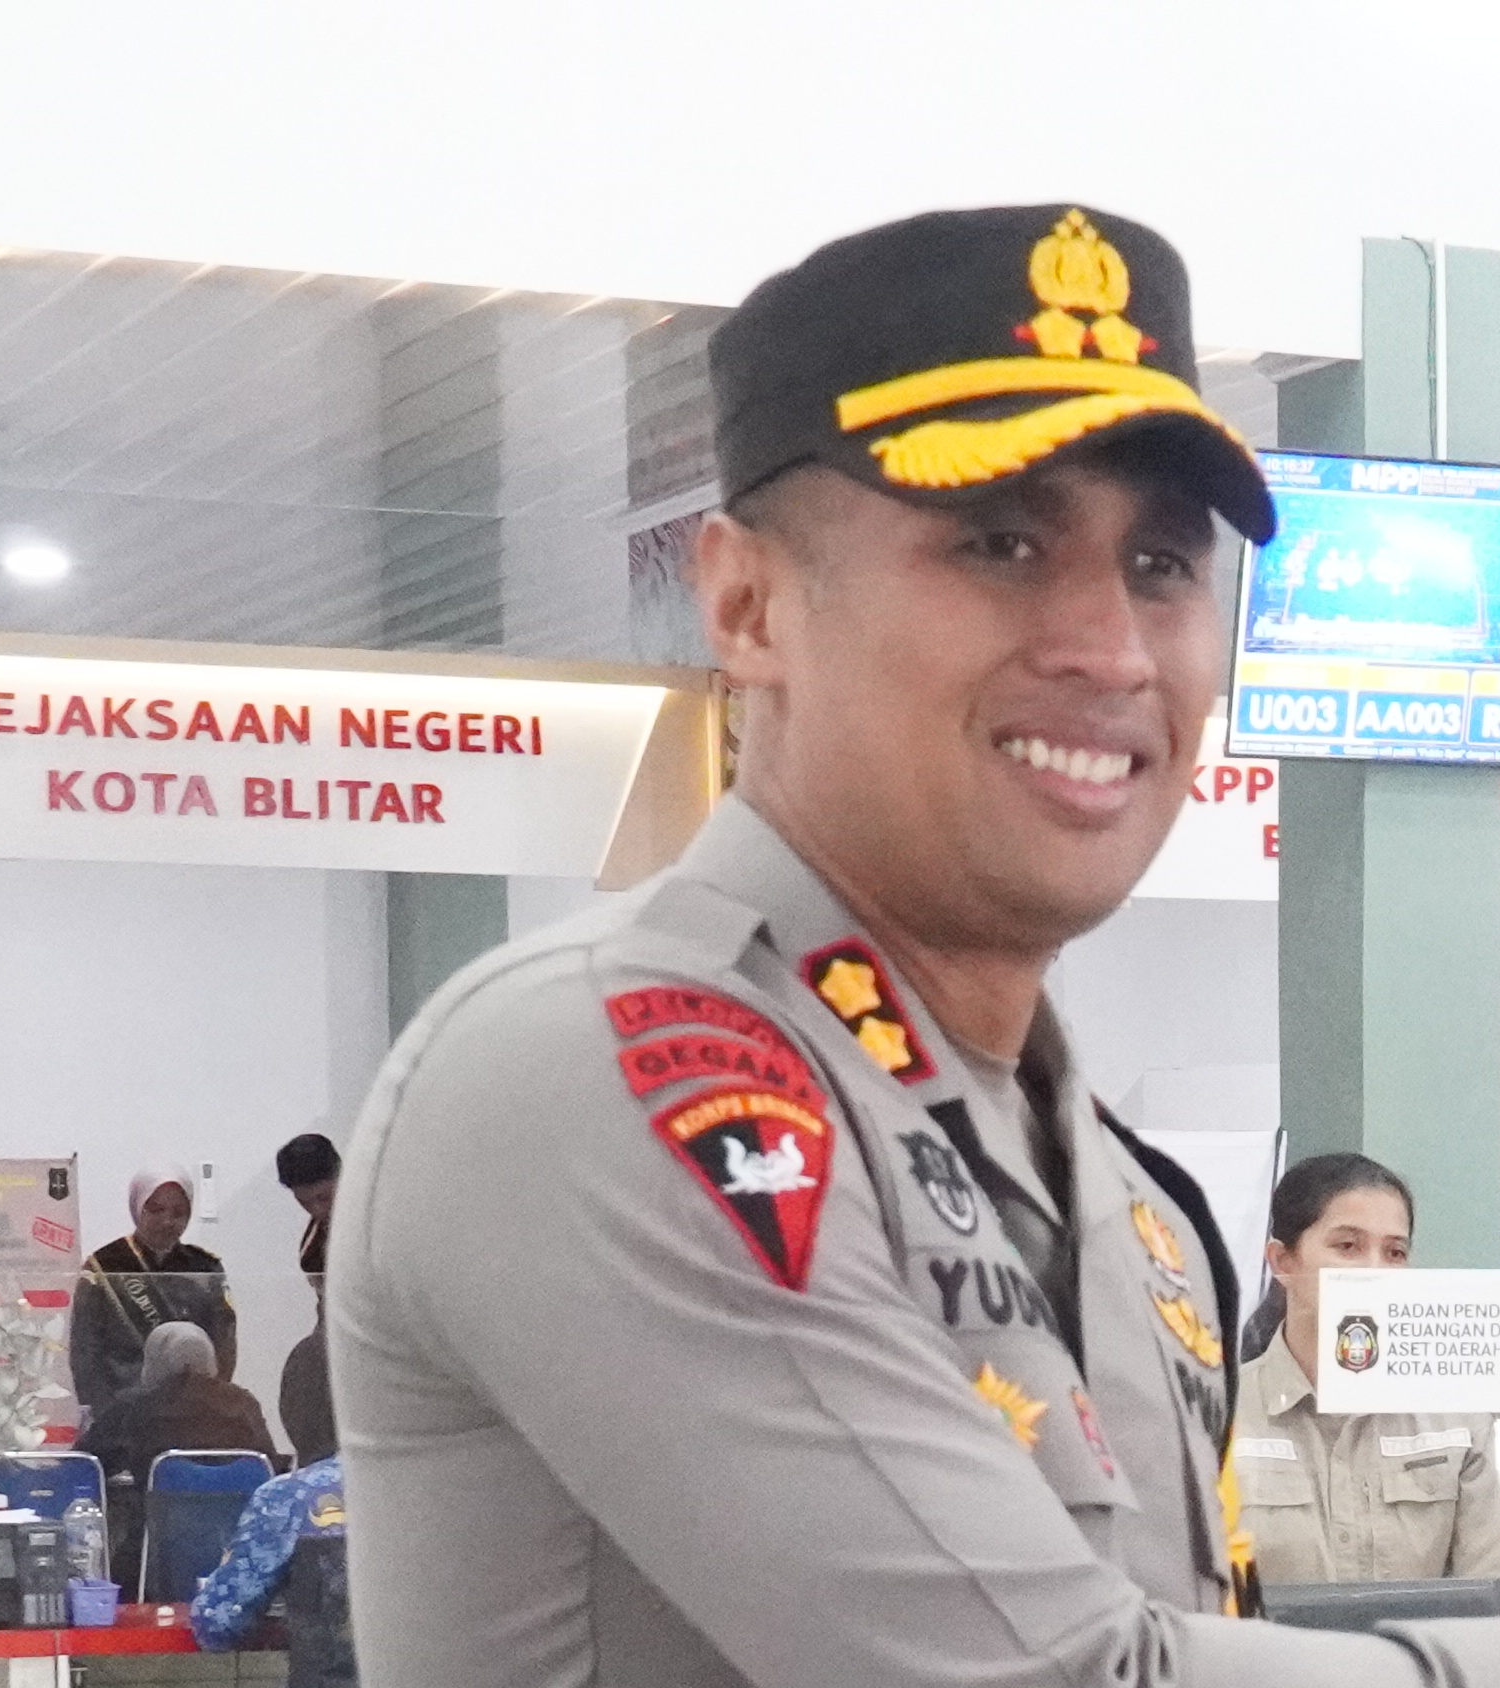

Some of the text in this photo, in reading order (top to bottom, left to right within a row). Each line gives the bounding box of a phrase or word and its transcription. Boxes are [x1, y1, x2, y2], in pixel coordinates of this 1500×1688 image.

[1351, 462, 1420, 493] MPP
[1249, 694, 1338, 732] U003
[1356, 700, 1462, 734] AA003
[340, 708, 542, 755] NEGERI
[47, 770, 446, 824] KOTA BLITAR
[1388, 1303, 1449, 1319] BADAN
[1387, 1322, 1485, 1338] KEUANGAN
[1387, 1342, 1431, 1357] ASET
[1387, 1360, 1496, 1376] KOTA BLITAR
